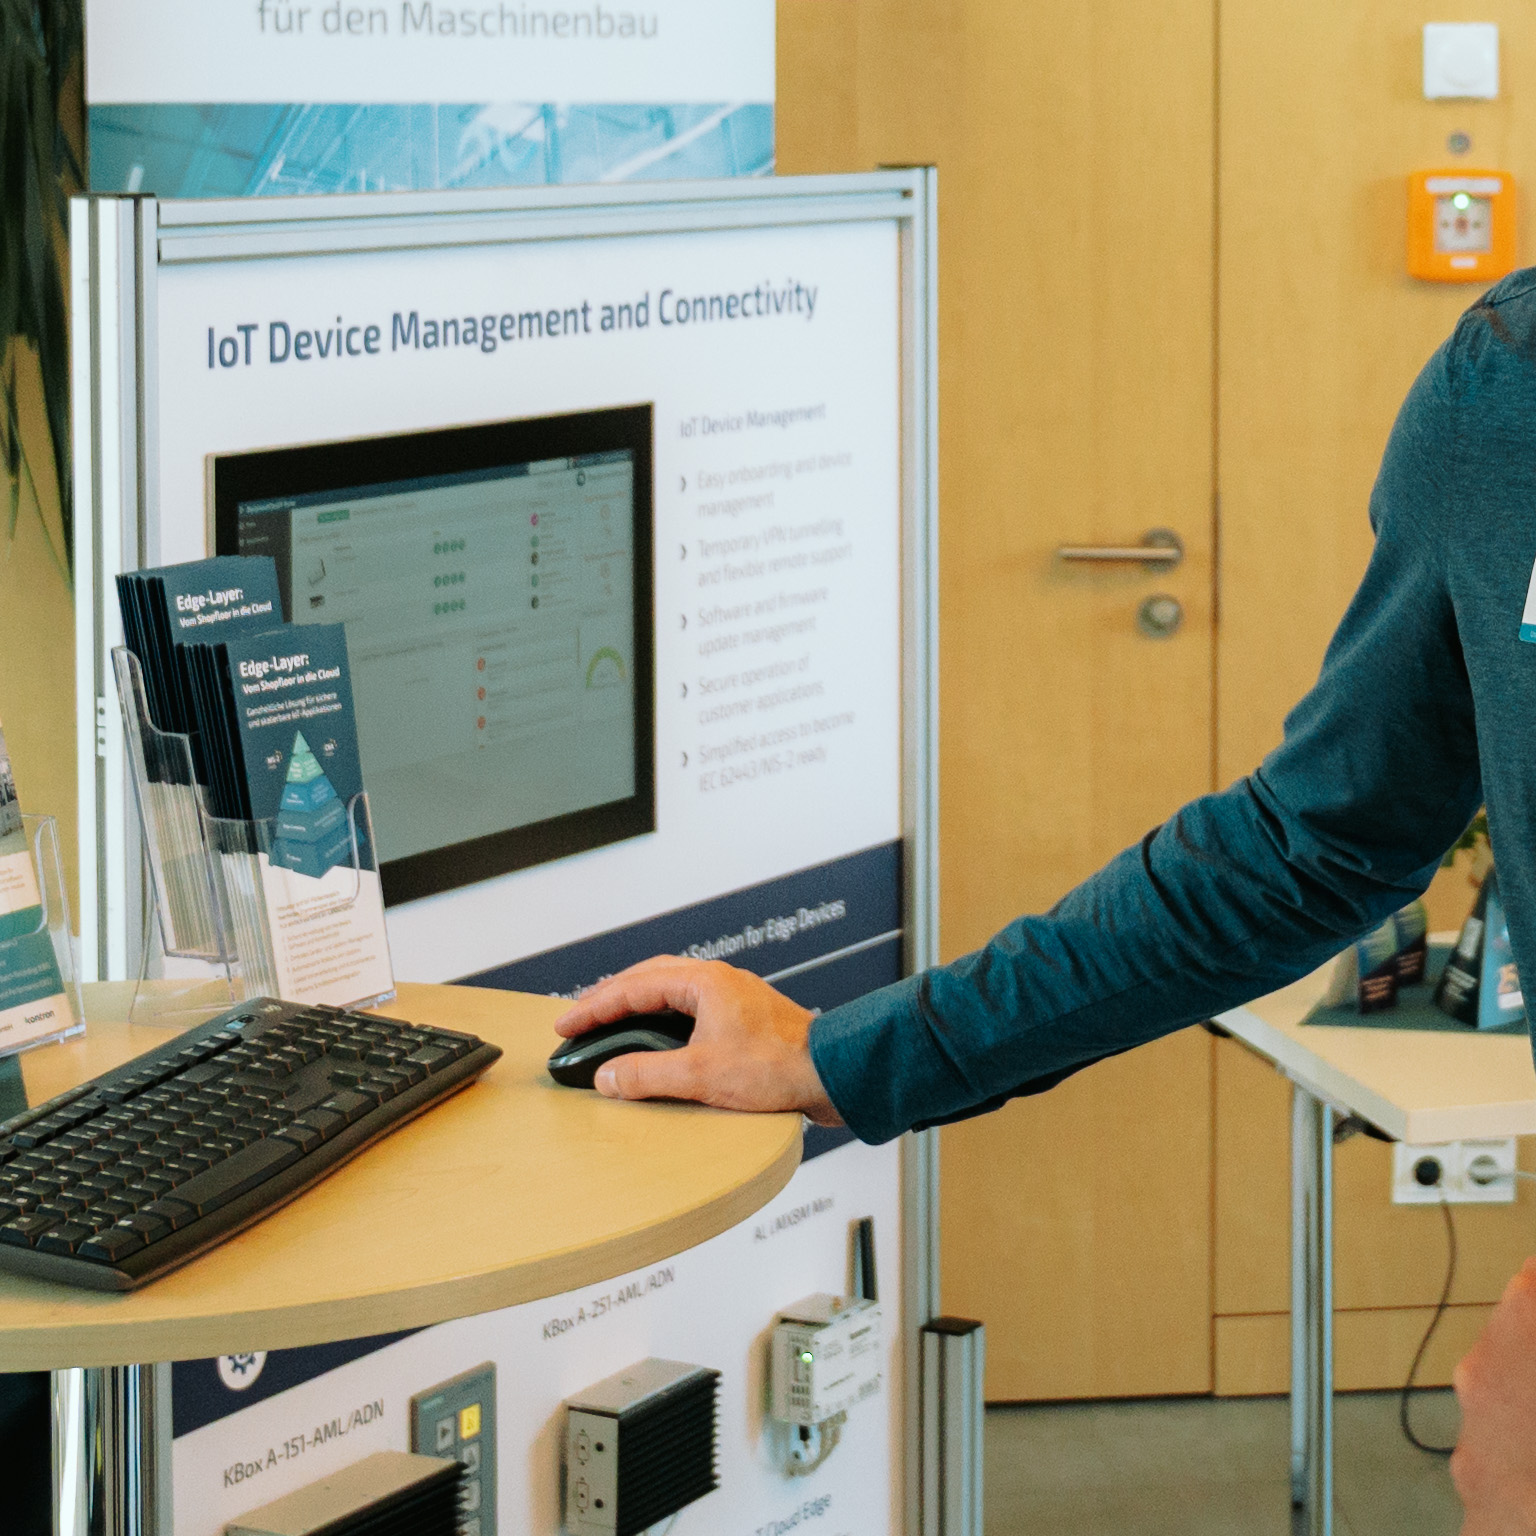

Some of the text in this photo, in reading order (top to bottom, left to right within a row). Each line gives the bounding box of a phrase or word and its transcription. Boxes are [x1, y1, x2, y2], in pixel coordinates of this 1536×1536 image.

[321, 0, 389, 35] den
[399, 0, 660, 40] Maschinenbau
[206, 279, 820, 370] IoT Device Management and Connectivity
[680, 403, 827, 438] IoT Device Management
[697, 471, 726, 492] Easy
[728, 459, 793, 487] onboarding
[698, 491, 775, 517] management
[697, 532, 760, 560] Temporary
[698, 567, 721, 587] and
[176, 588, 244, 612] Edge-Layer:
[179, 616, 197, 629] Vom
[197, 611, 232, 626] Shopfloor
[240, 604, 252, 616] die
[252, 600, 273, 614] Cloud
[698, 600, 751, 628] Software
[699, 616, 816, 658] update management
[239, 654, 310, 677] Edge-Layer:
[242, 683, 261, 695] Vom
[260, 677, 296, 692] Shopfloor
[304, 670, 317, 683] die
[317, 666, 341, 681] Cloud
[698, 673, 739, 697] Secure
[699, 680, 824, 726] customer applications
[699, 736, 757, 765] Simplified
[689, 899, 846, 961] Solution for Edge Devices
[24, 1010, 55, 1025] kontron
[541, 1318, 574, 1342] KBox
[223, 1398, 384, 1488] KBox A-151-AML/ADN
